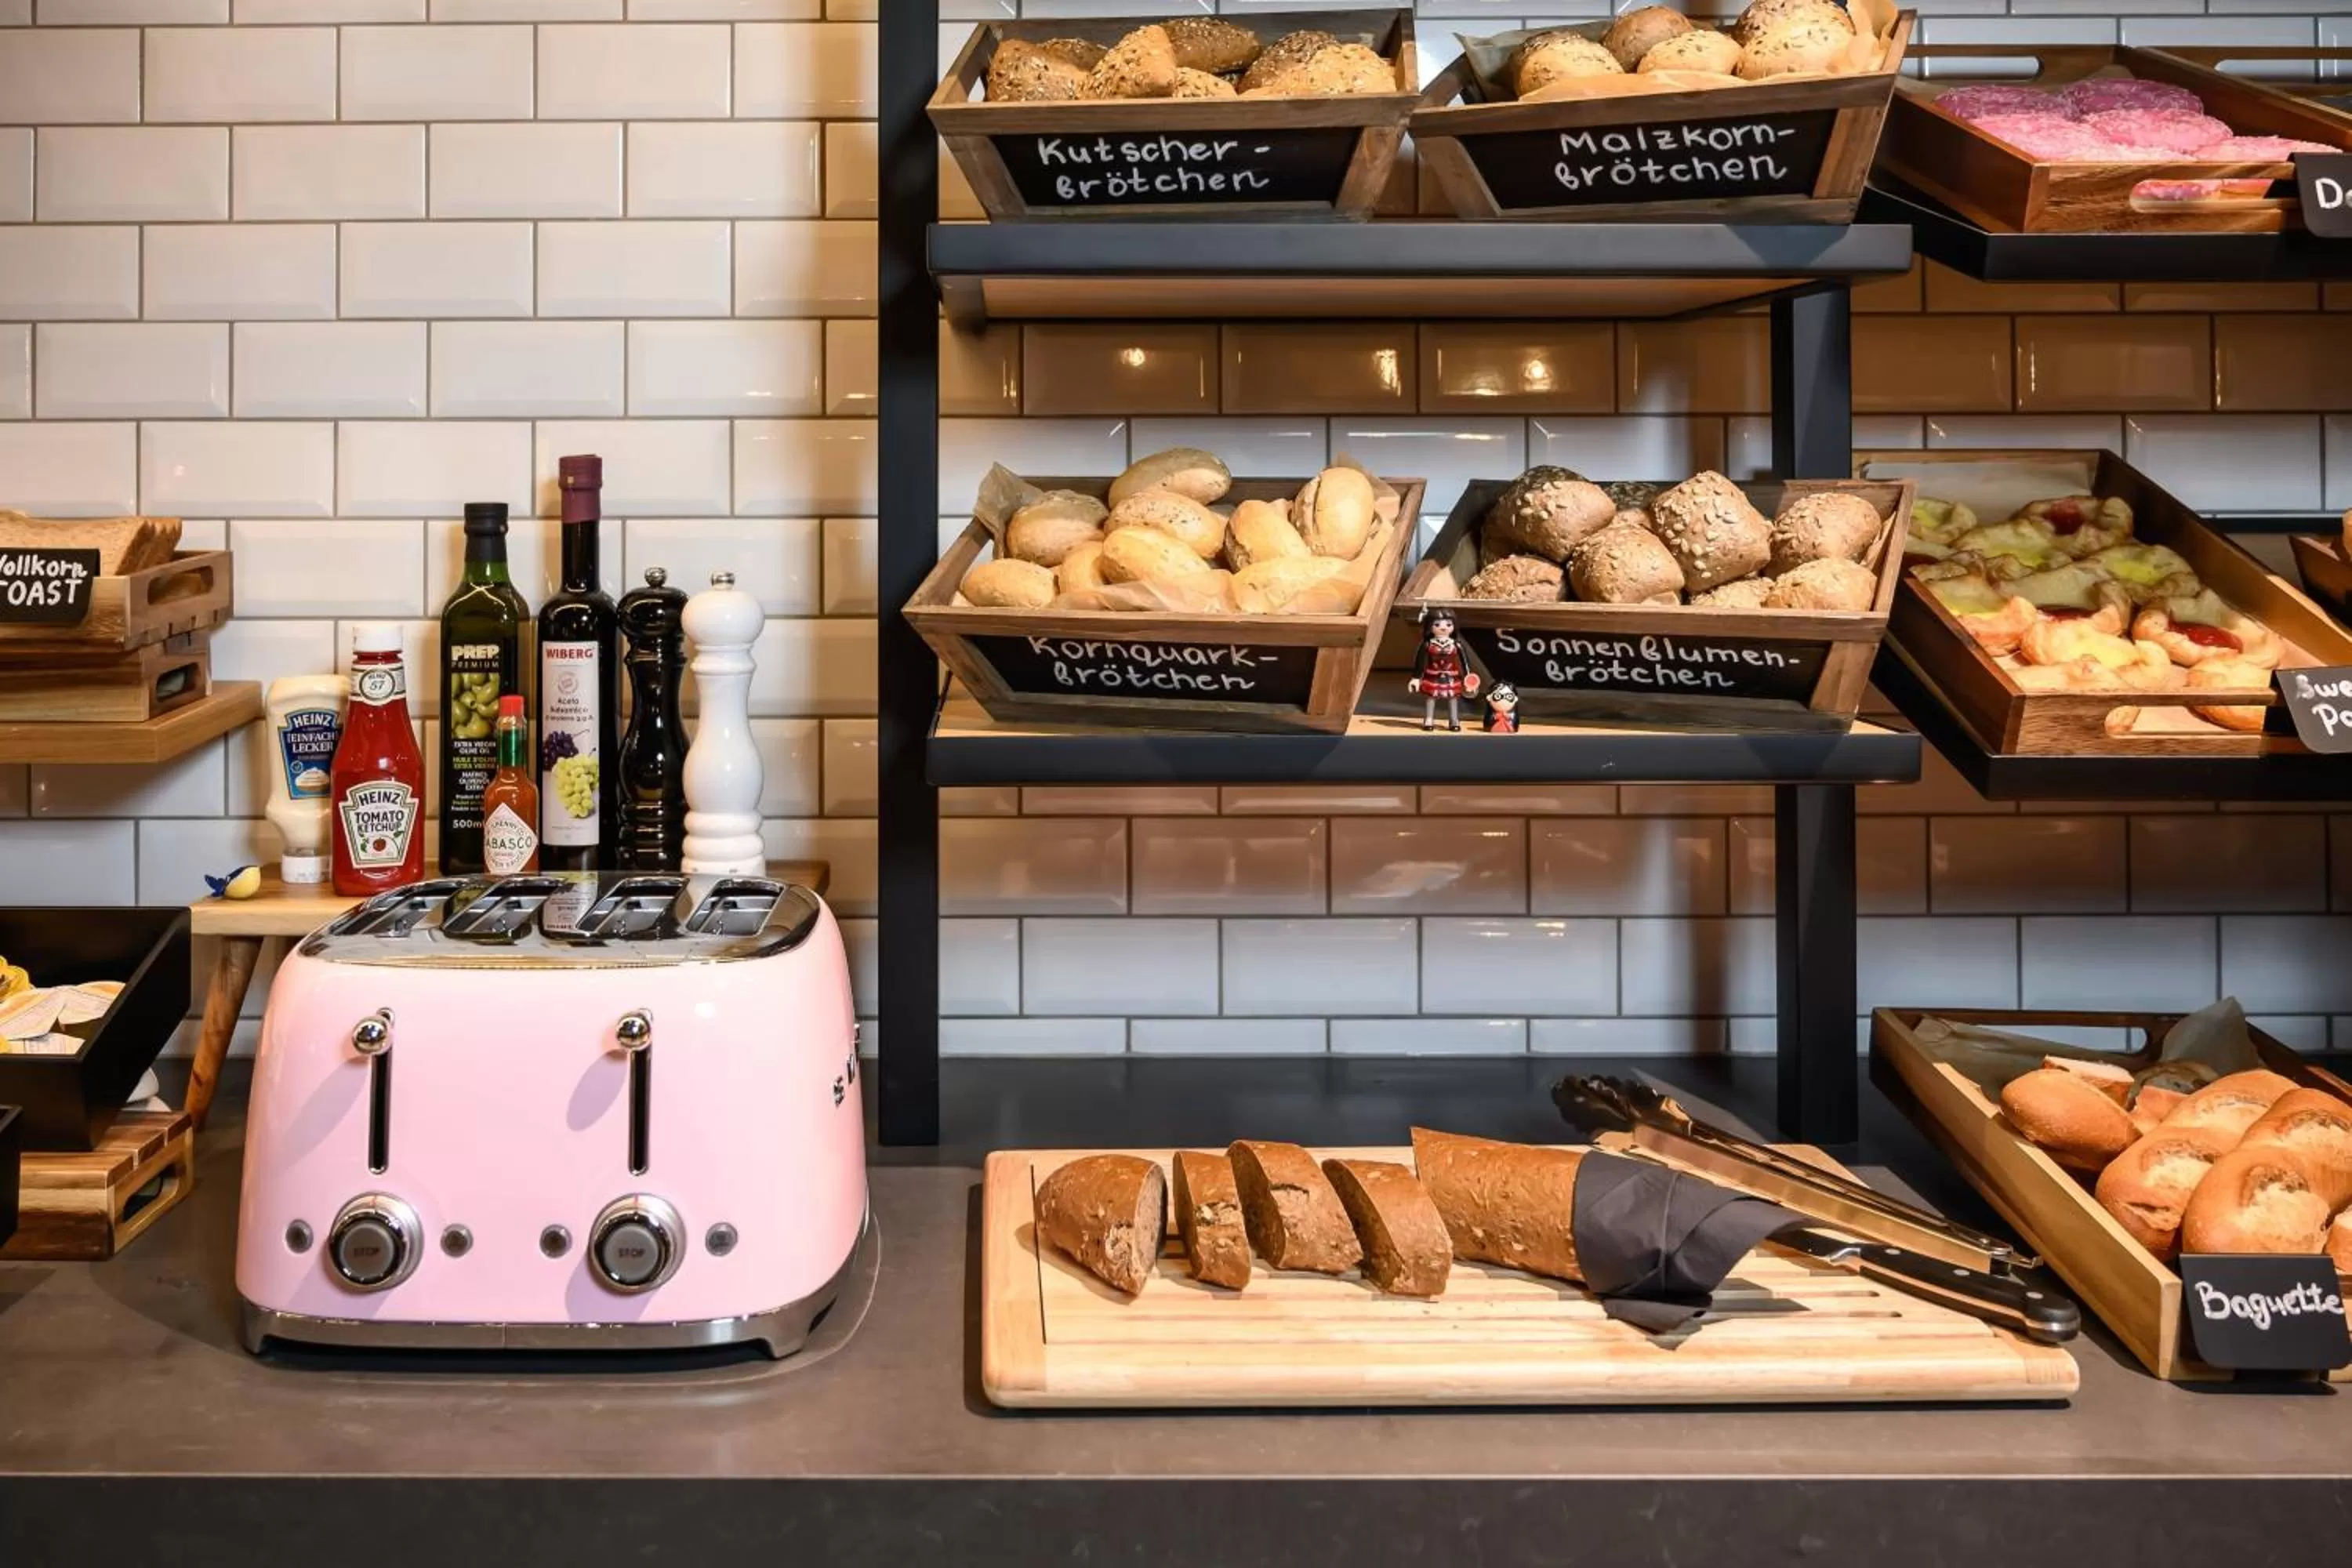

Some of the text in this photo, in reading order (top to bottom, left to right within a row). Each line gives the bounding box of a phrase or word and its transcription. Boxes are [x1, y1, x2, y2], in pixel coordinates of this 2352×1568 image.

[1560, 124, 1795, 156] Malzkorn-
[546, 648, 593, 659] WIBERG
[1027, 634, 1279, 667] Kornquark-
[292, 713, 333, 728] HEINZ
[292, 741, 333, 753] LECKER
[358, 790, 401, 806] HEINZ
[354, 810, 405, 823] TOMATO
[358, 822, 401, 833] KETCHUP
[2194, 1280, 2345, 1330] Baguette
